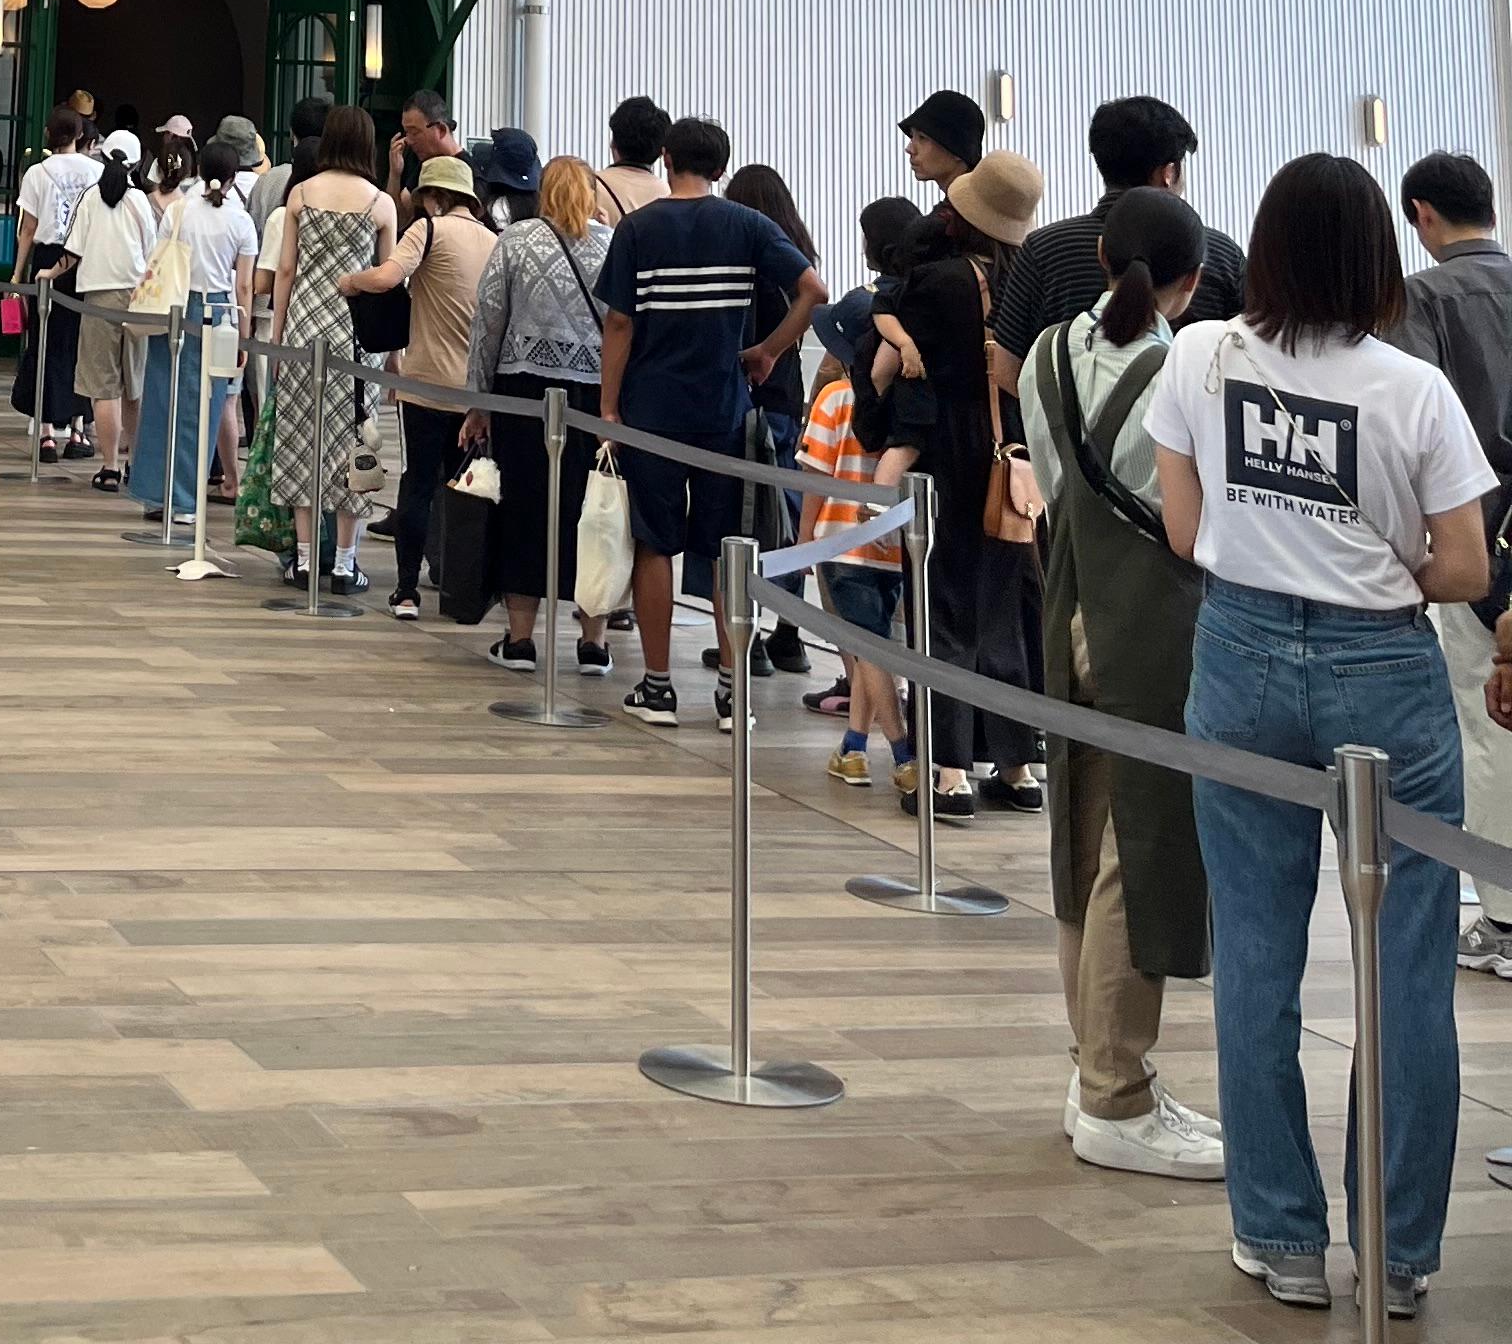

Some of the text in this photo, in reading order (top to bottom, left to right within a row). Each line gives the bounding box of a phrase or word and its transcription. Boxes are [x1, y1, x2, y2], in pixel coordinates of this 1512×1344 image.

[1242, 400, 1337, 474] HH
[1245, 456, 1283, 473] HELLY
[1226, 487, 1360, 524] BE WITH WATER
